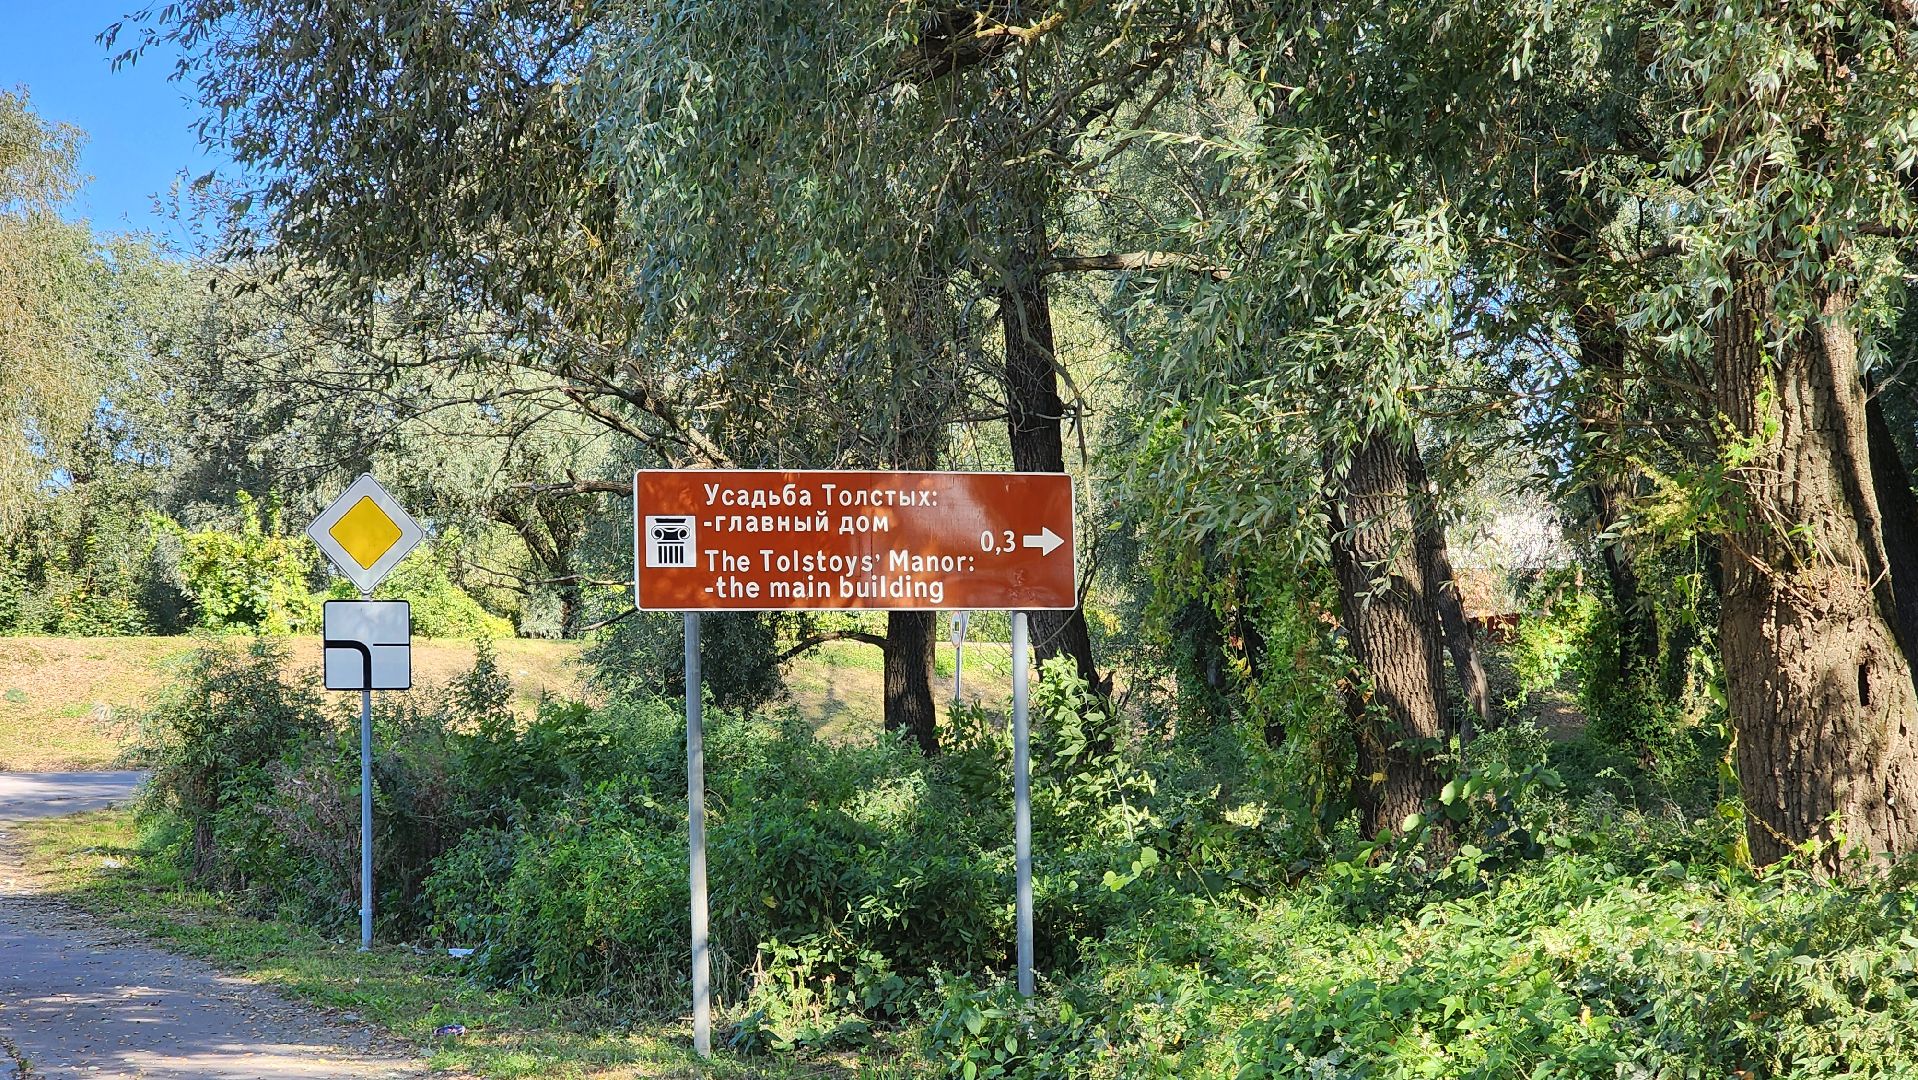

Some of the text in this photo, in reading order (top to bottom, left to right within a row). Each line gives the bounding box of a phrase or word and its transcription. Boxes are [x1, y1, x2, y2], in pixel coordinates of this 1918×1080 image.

[704, 483, 937, 508] Усадьба Толстых:
[704, 510, 888, 535] -главный дом
[980, 530, 1016, 555] 0,3
[704, 550, 750, 572] The
[889, 550, 974, 572] Manor:
[704, 575, 943, 603] -the main building
